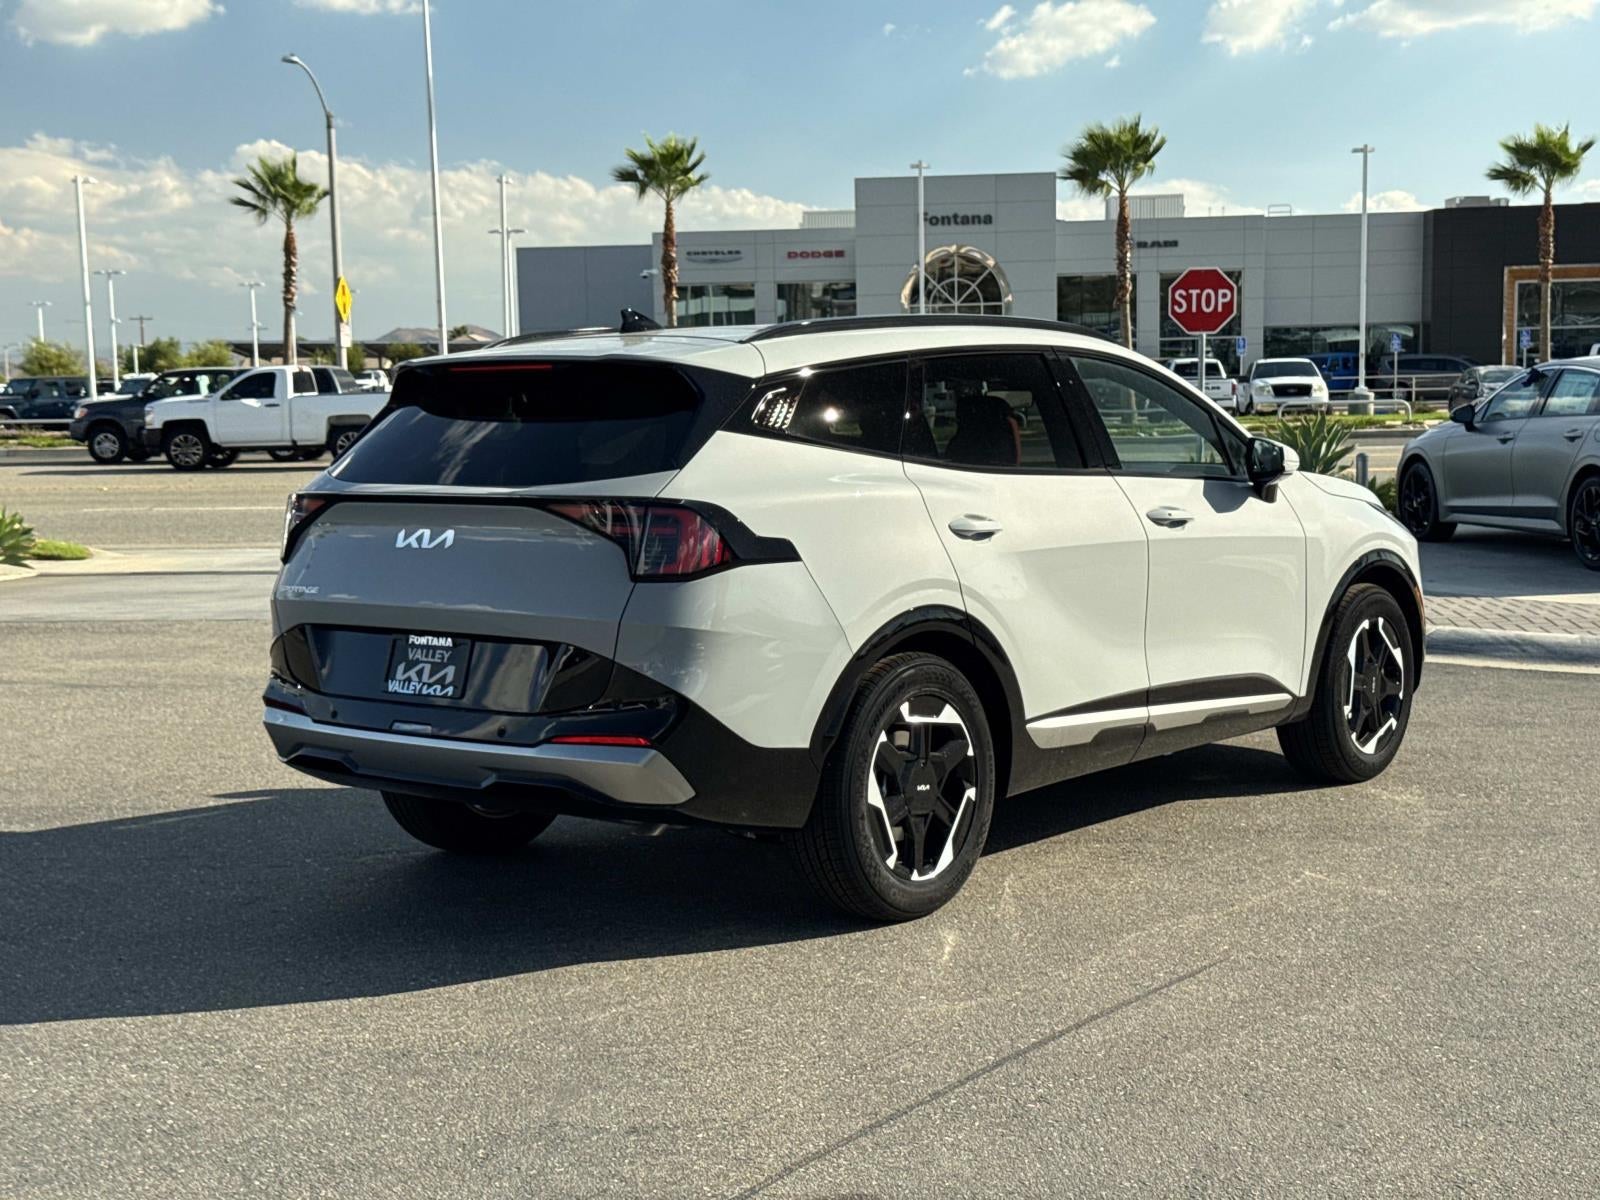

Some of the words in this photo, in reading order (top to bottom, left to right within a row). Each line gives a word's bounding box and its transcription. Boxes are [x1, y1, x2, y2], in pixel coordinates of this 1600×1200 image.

[686, 249, 742, 257] CHRYSLER
[787, 250, 845, 260] DODGE
[1173, 288, 1232, 313] STOP
[395, 528, 455, 549] KIA
[408, 634, 453, 647] FONTANA
[408, 647, 452, 663] VALLEY
[395, 662, 456, 685] KIA
[388, 679, 422, 695] VALLEY
